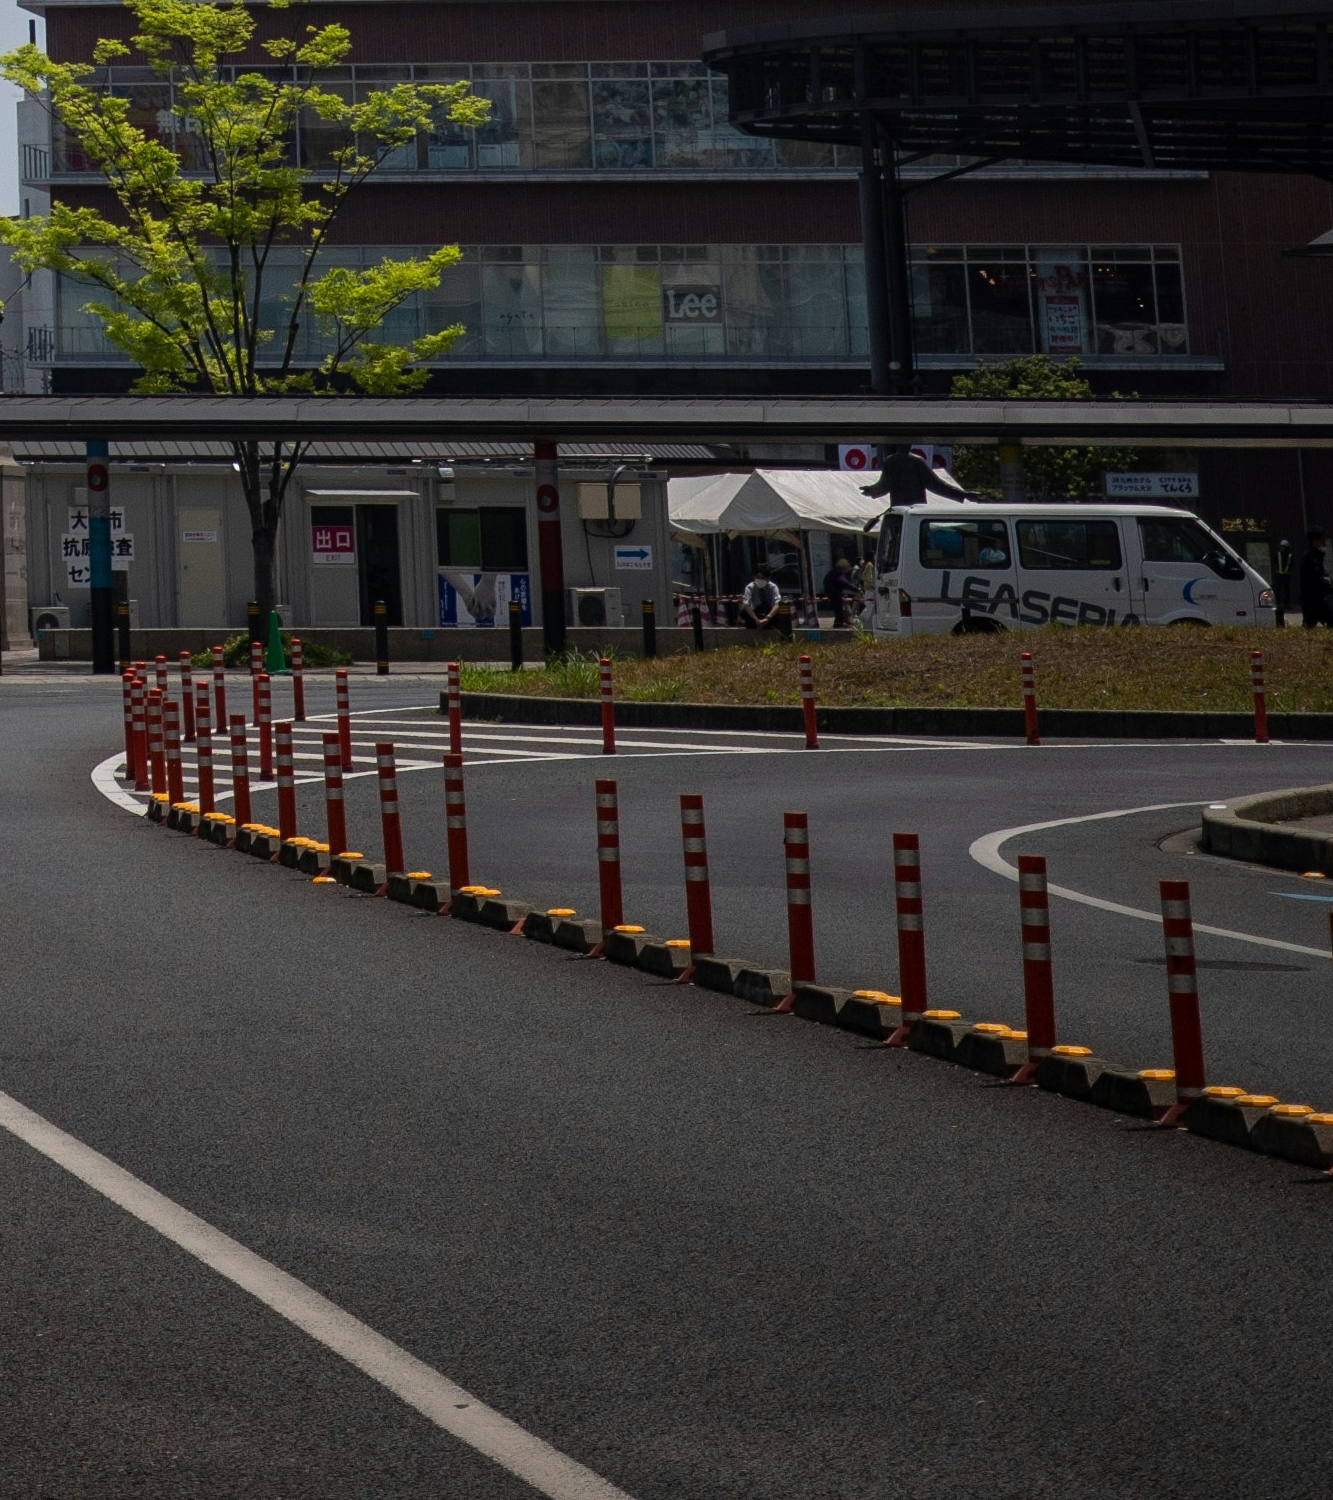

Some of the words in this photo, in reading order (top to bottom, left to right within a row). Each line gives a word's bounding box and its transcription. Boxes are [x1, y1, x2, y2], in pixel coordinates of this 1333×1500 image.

[664, 289, 718, 319] Lee
[71, 510, 123, 530] 大市
[63, 538, 133, 557] 抗原査
[316, 529, 350, 549] 出口
